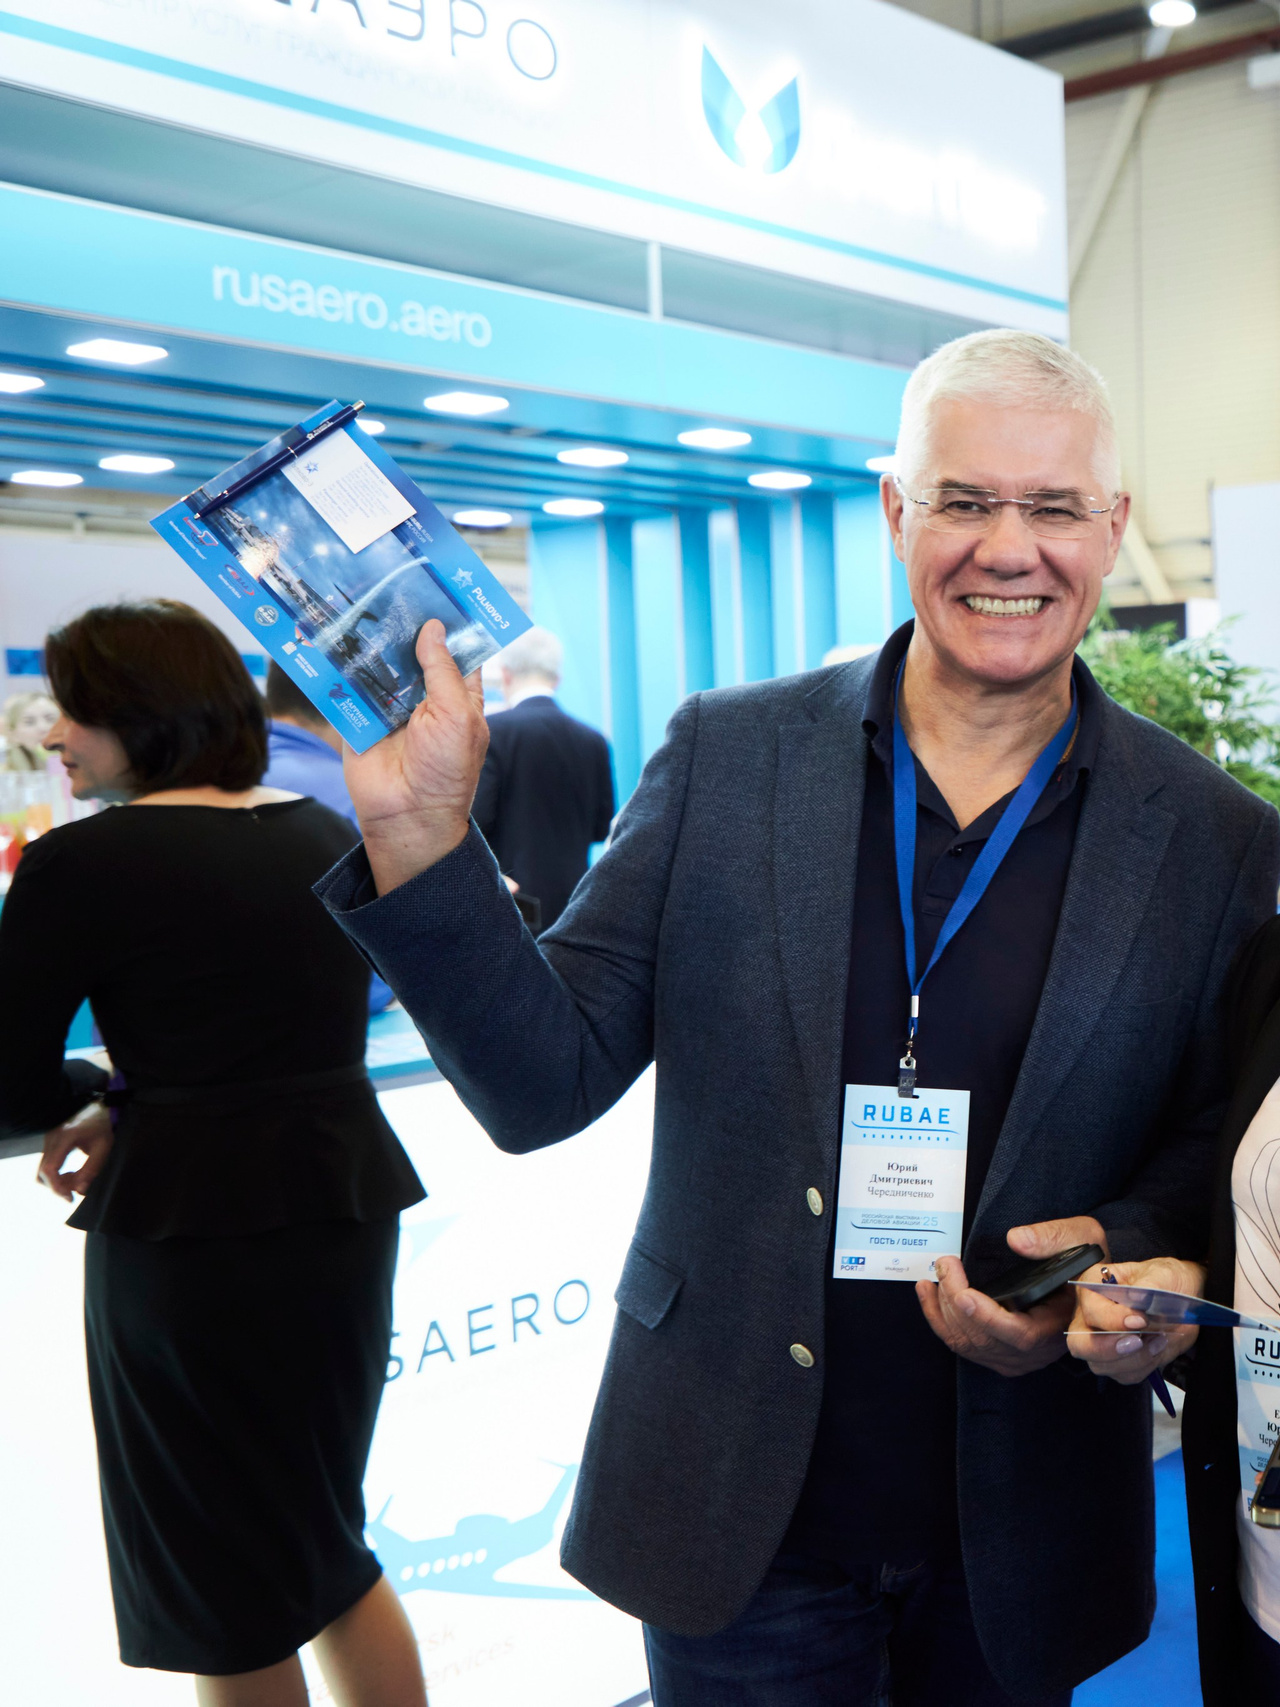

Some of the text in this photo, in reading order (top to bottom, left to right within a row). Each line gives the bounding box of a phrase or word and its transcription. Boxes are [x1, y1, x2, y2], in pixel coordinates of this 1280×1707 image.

[212, 264, 494, 348] rusaero.aero
[471, 586, 510, 630] PULKOVO-3
[339, 701, 363, 728] PEGASUS
[344, 697, 370, 726] SAPPHIRE
[863, 1104, 950, 1124] RUBAE
[887, 1162, 918, 1173] Юрий
[869, 1174, 933, 1186] Дмитриевич
[867, 1186, 934, 1198] Чередниченко
[869, 1236, 896, 1245] ГОСТЬ
[902, 1238, 928, 1247] GUEST
[424, 1638, 516, 1692] ervices
